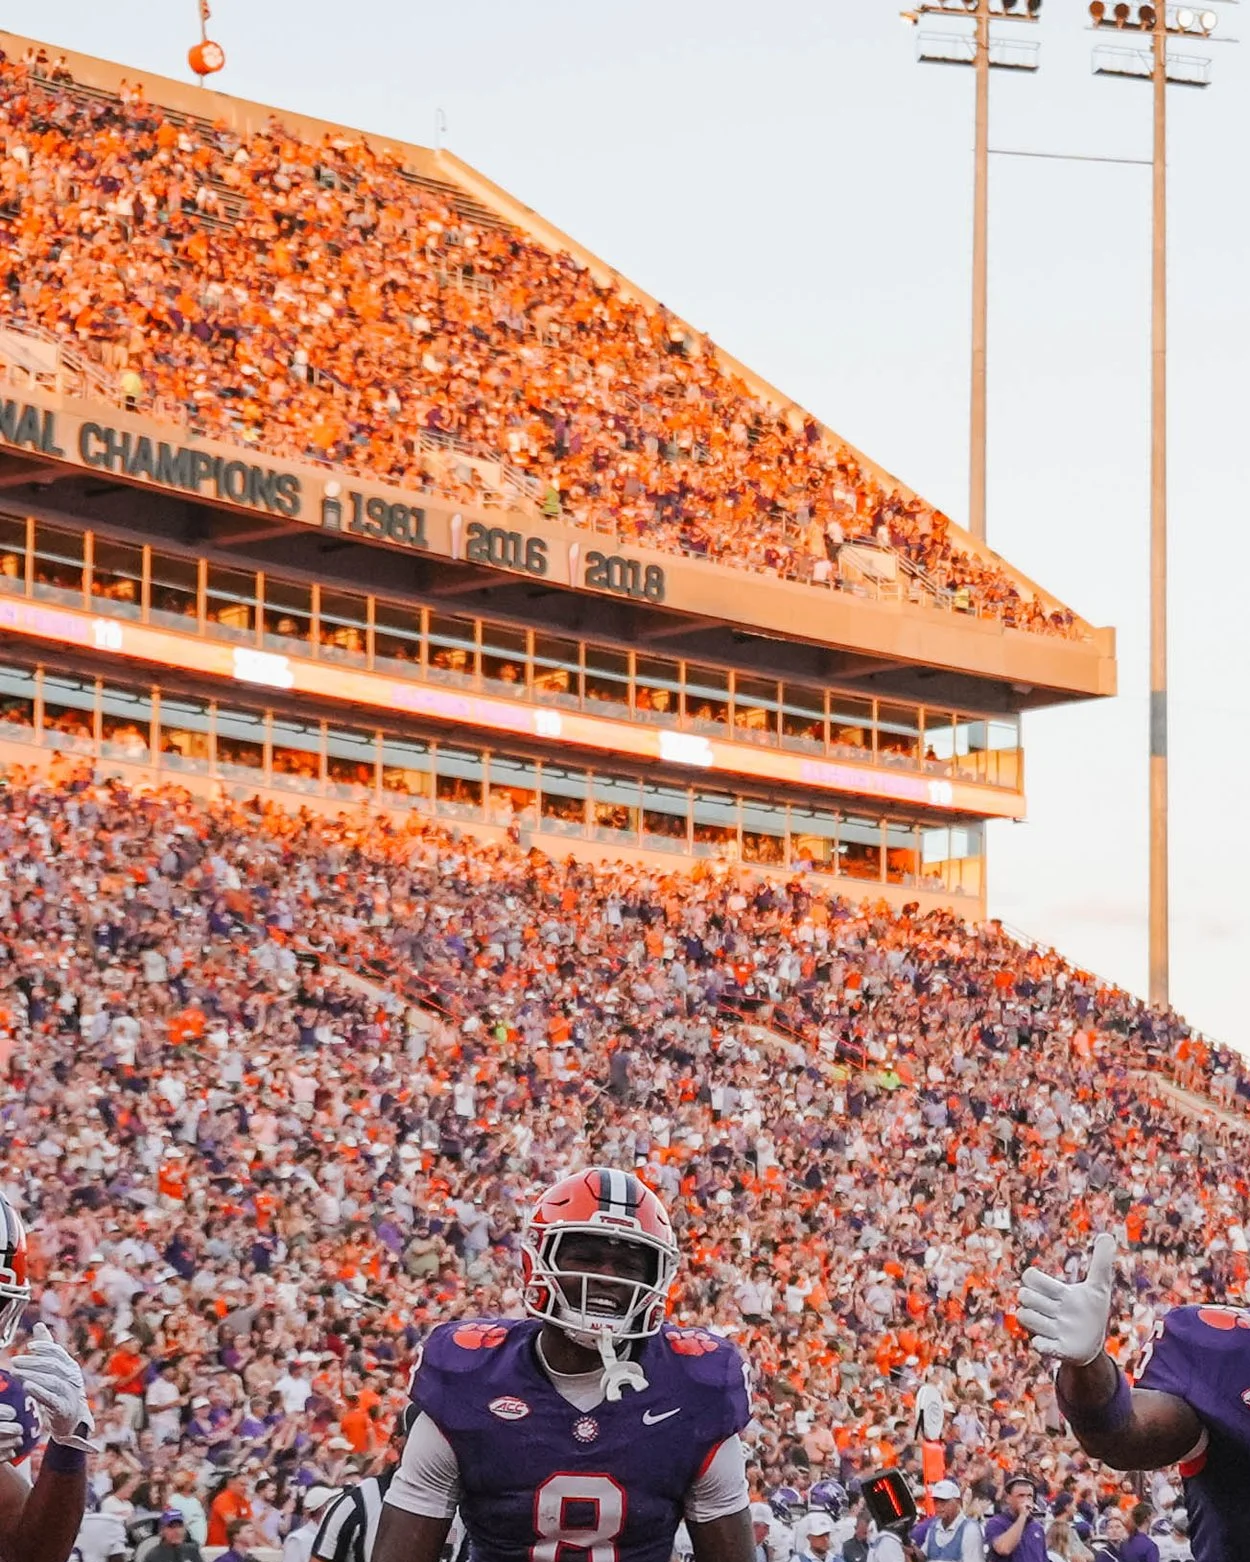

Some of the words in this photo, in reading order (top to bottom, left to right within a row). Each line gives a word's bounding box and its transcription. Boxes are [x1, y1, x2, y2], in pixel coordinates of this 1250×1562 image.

[79, 421, 302, 516] CHAMPIONS
[348, 491, 428, 548] 1981
[466, 522, 548, 576] 2016
[585, 551, 665, 602] 2018
[494, 1402, 525, 1414] ACC
